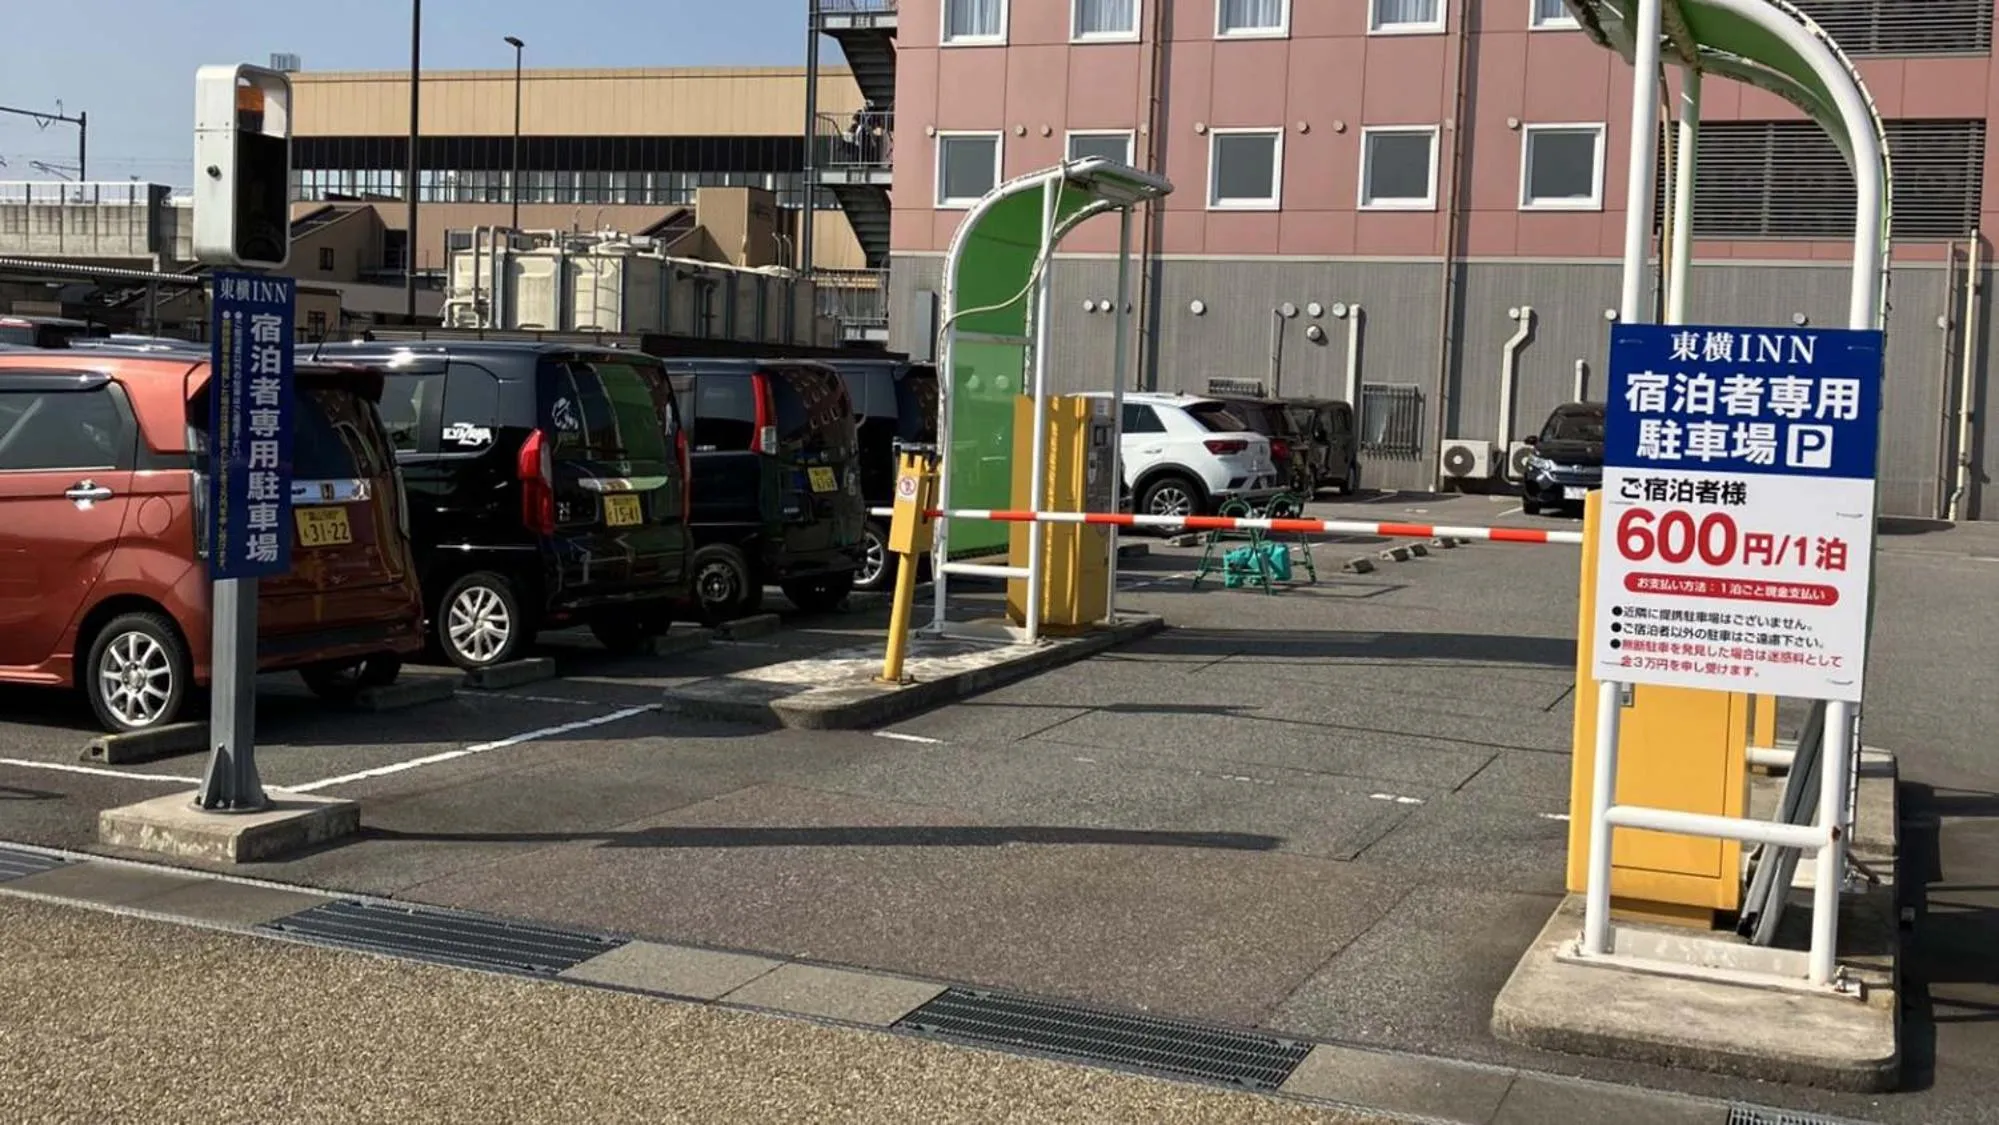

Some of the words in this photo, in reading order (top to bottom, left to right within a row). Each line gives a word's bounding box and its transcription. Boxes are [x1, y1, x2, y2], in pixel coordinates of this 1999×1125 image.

[220, 277, 288, 304] 東横INN
[1669, 330, 1817, 364] 東横INN
[1624, 370, 1861, 421] 宿泊者専用
[245, 312, 282, 562] 宿泊者専用駐車場
[1636, 419, 1778, 465] 駐車場
[1619, 477, 1748, 506] ご宿泊者様
